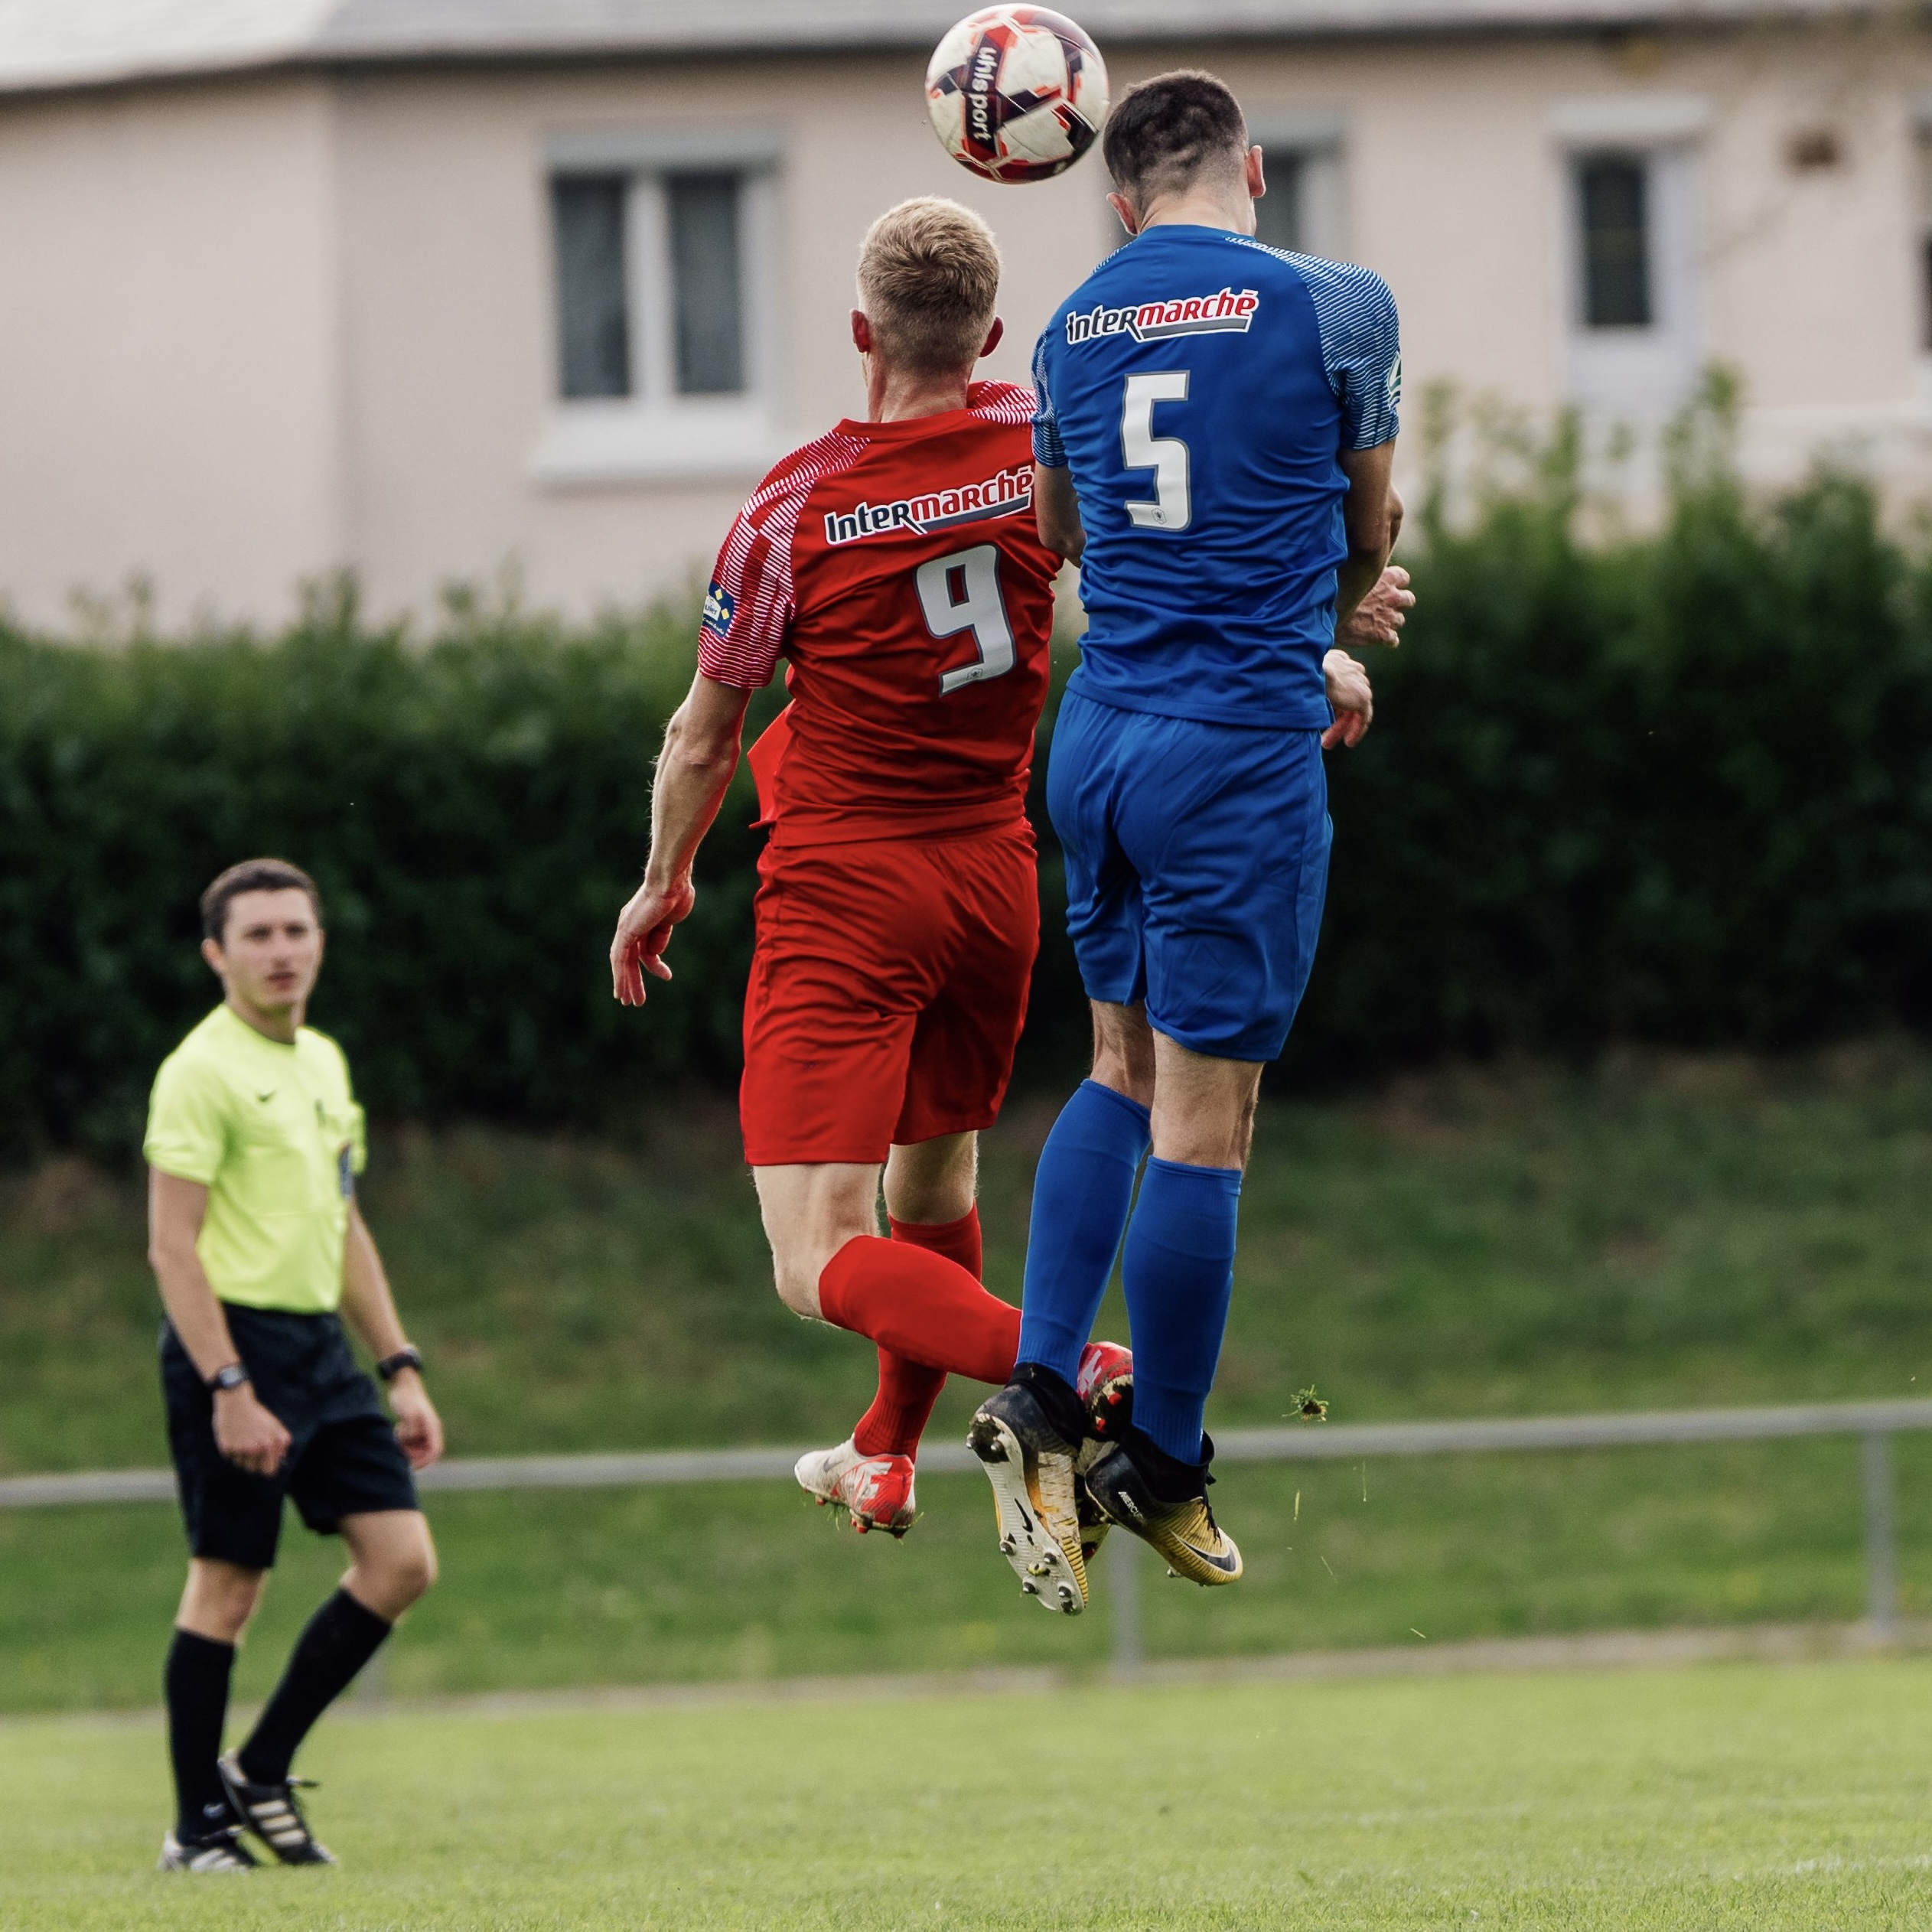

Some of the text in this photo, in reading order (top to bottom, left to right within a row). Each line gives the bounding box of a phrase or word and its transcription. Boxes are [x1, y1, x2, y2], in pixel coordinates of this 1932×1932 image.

[971, 46, 998, 141] uhlsport
[1067, 288, 1258, 343] Intermarché
[1120, 370, 1191, 532] 5
[826, 468, 1034, 543] Intermarché
[914, 542, 1016, 697] 9
